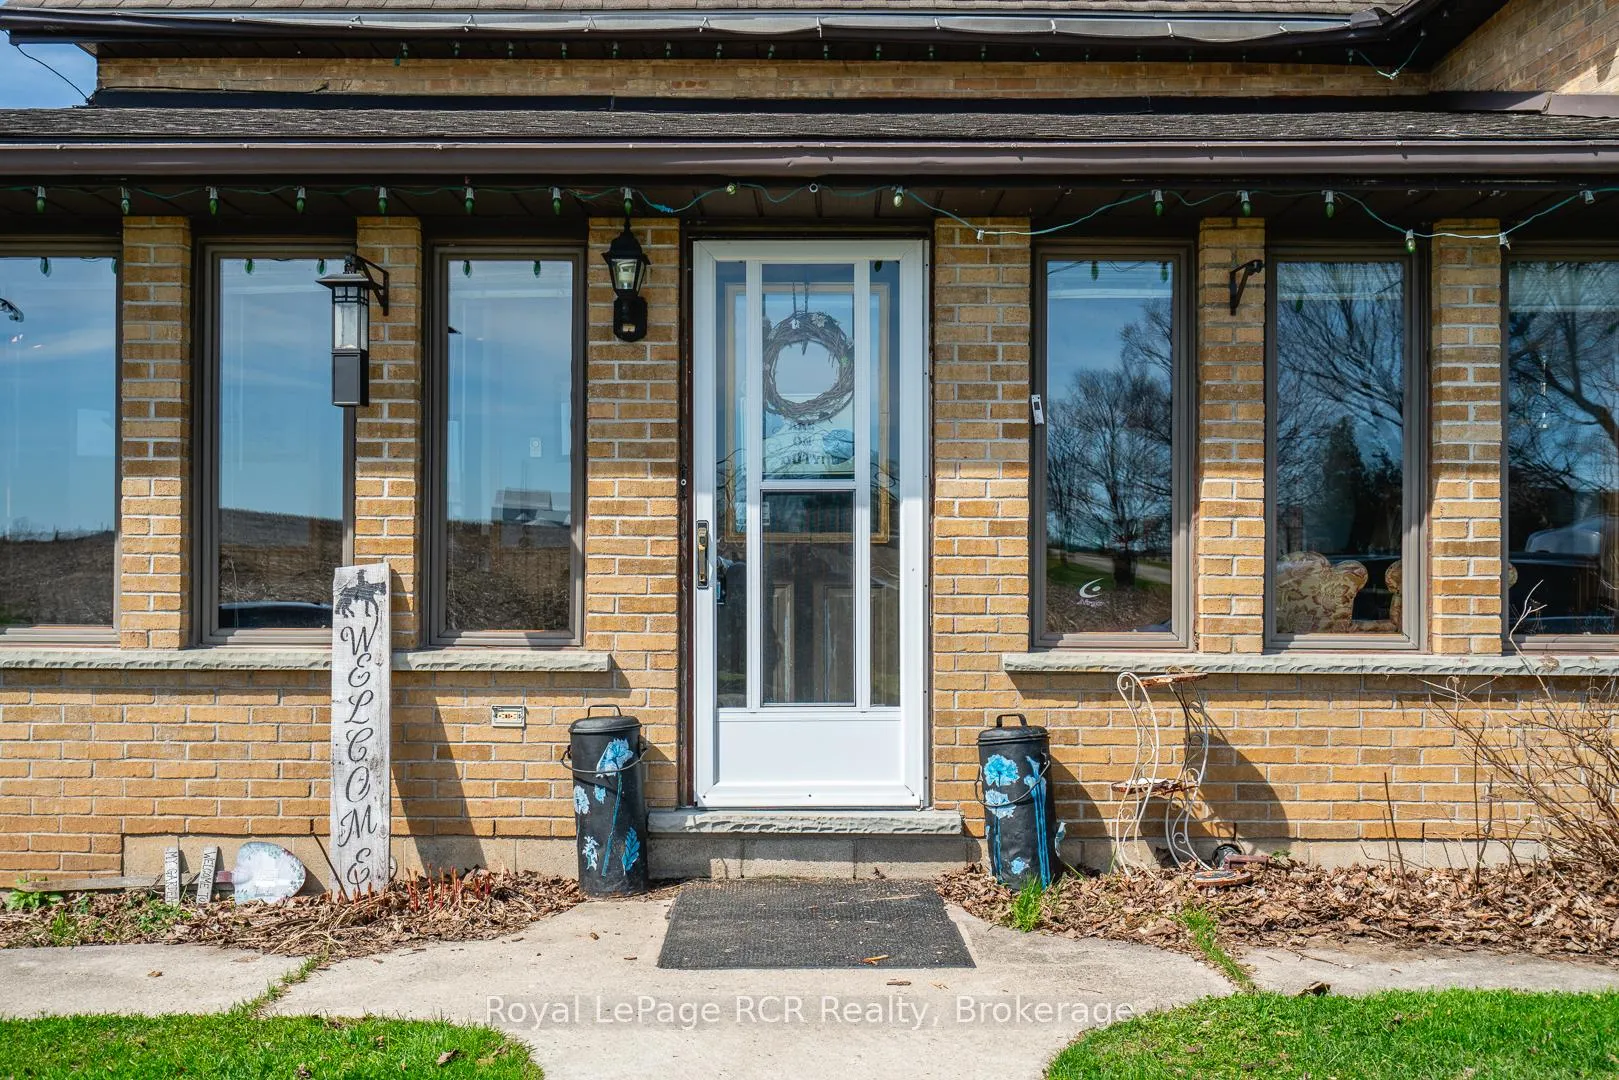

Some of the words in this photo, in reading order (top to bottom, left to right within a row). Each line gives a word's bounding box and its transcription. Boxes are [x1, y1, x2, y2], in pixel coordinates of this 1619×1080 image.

[338, 620, 378, 886] WELCOME
[165, 851, 178, 864] MY
[199, 851, 217, 889] WELCOME
[197, 892, 209, 903] TO
